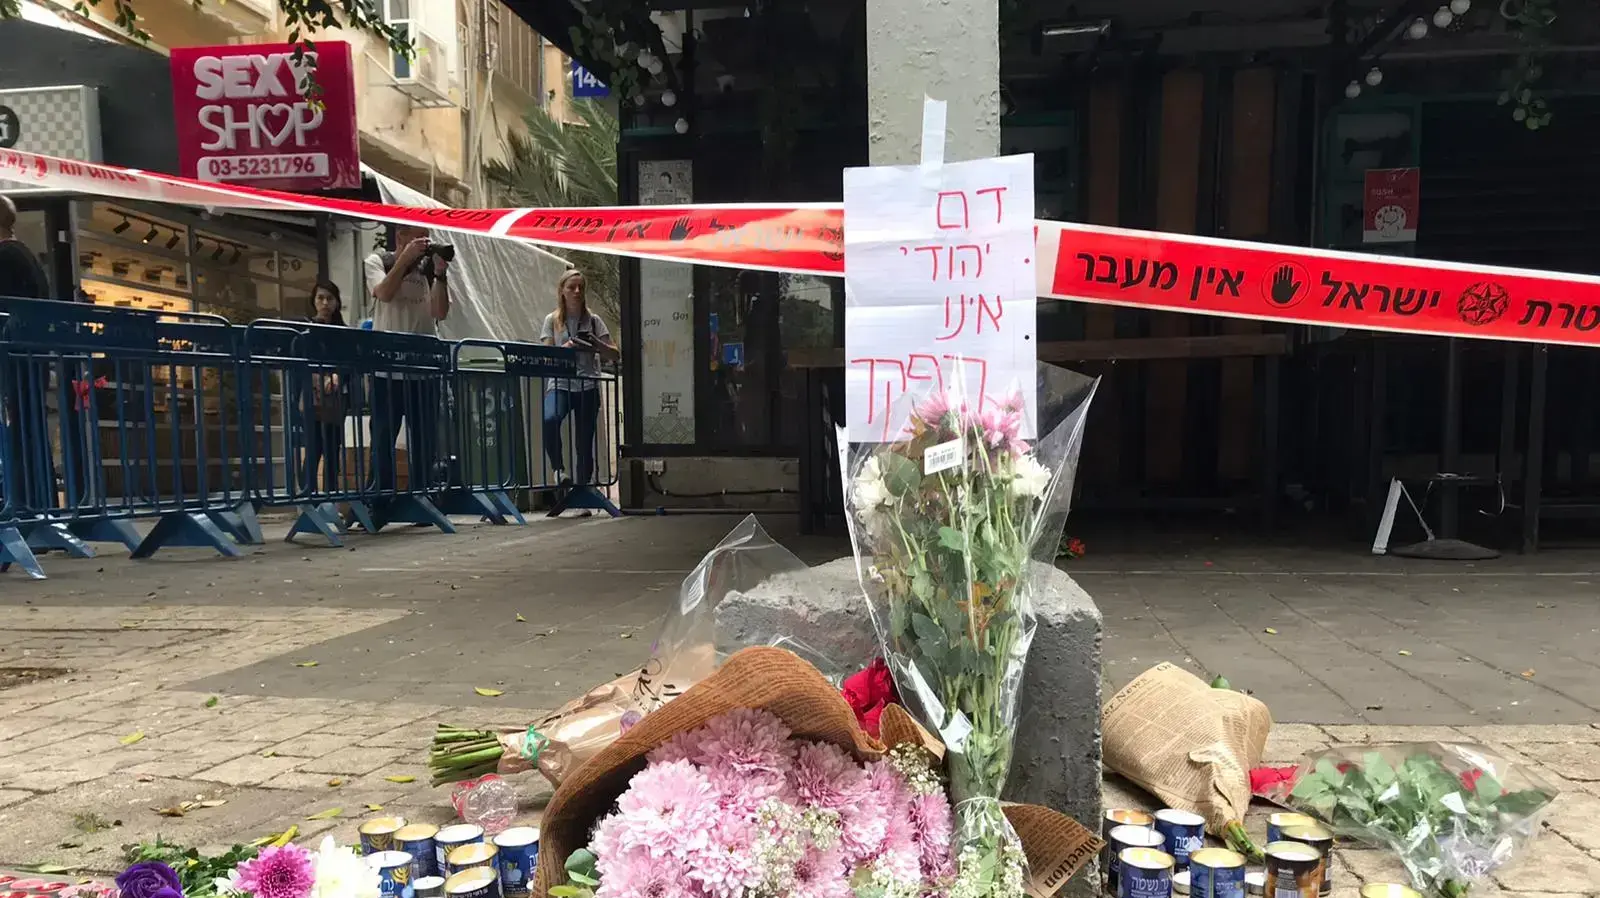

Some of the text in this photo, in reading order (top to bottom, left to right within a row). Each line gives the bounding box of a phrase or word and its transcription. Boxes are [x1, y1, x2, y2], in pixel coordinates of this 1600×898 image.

[193, 52, 319, 100] SEXY
[208, 156, 316, 176] 03-5231796
[533, 214, 603, 234] מעבר
[936, 186, 1008, 229] דם
[605, 217, 653, 243] אין
[900, 243, 991, 281] יהודי
[1076, 252, 1179, 290] מעבר
[1189, 265, 1245, 300] אין
[1320, 271, 1442, 315] ישראל
[935, 293, 1004, 341] אינו
[1131, 876, 1159, 892] נשמה
